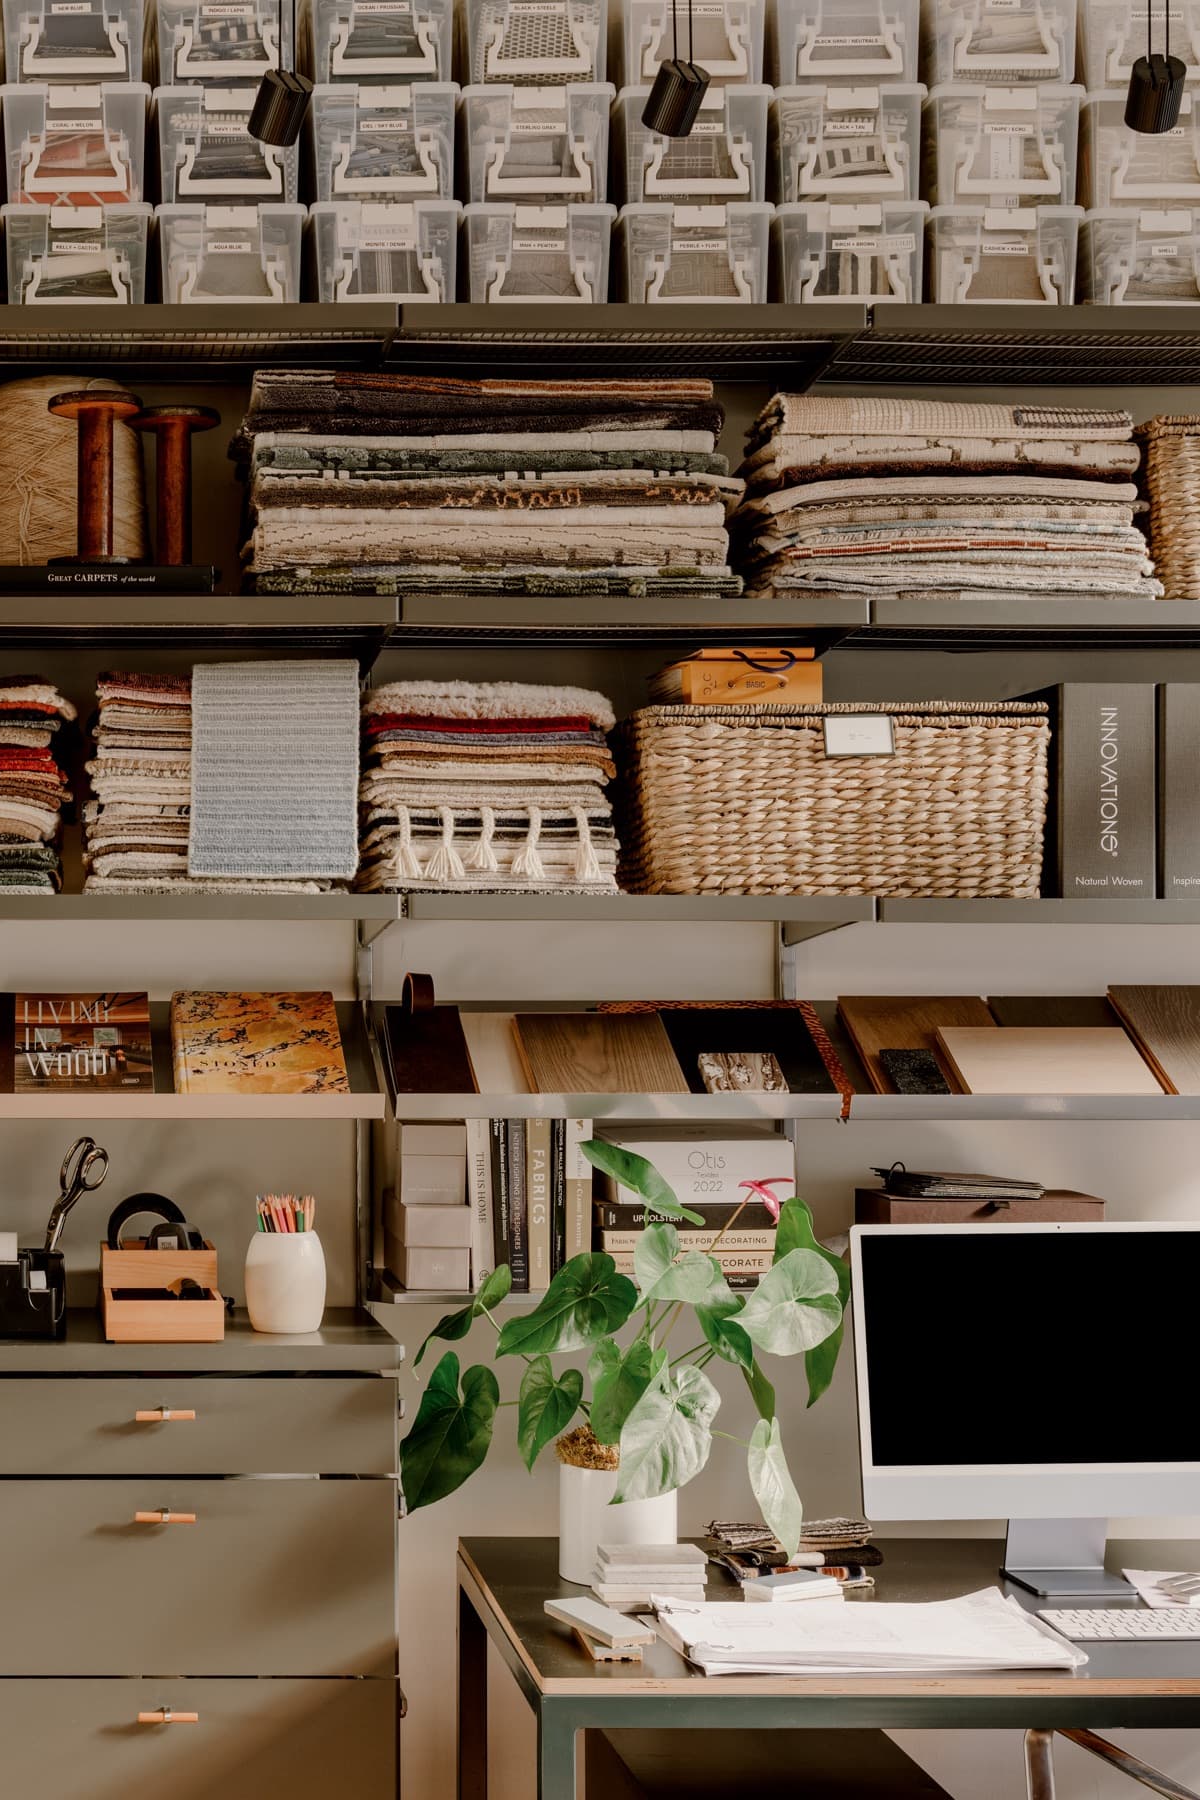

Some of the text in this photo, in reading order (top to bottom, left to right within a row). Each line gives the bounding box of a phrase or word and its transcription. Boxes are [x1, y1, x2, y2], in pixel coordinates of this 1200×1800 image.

[74, 573, 118, 582] CARPETS
[120, 575, 128, 584] of
[1074, 876, 1143, 886] Natural Woven
[24, 1000, 108, 1024] LIVING
[25, 1027, 48, 1051] IN
[25, 1052, 107, 1076] WOOD
[513, 1131, 521, 1162] INTERIOR
[687, 1151, 727, 1169] Otis
[475, 1151, 487, 1225] THIS IS HOME
[513, 1163, 521, 1196] LIGHTING
[533, 1149, 545, 1225] FABRICS
[693, 1181, 723, 1192] 2022
[695, 1237, 712, 1245] FOR
[717, 1237, 768, 1245] ECORATING
